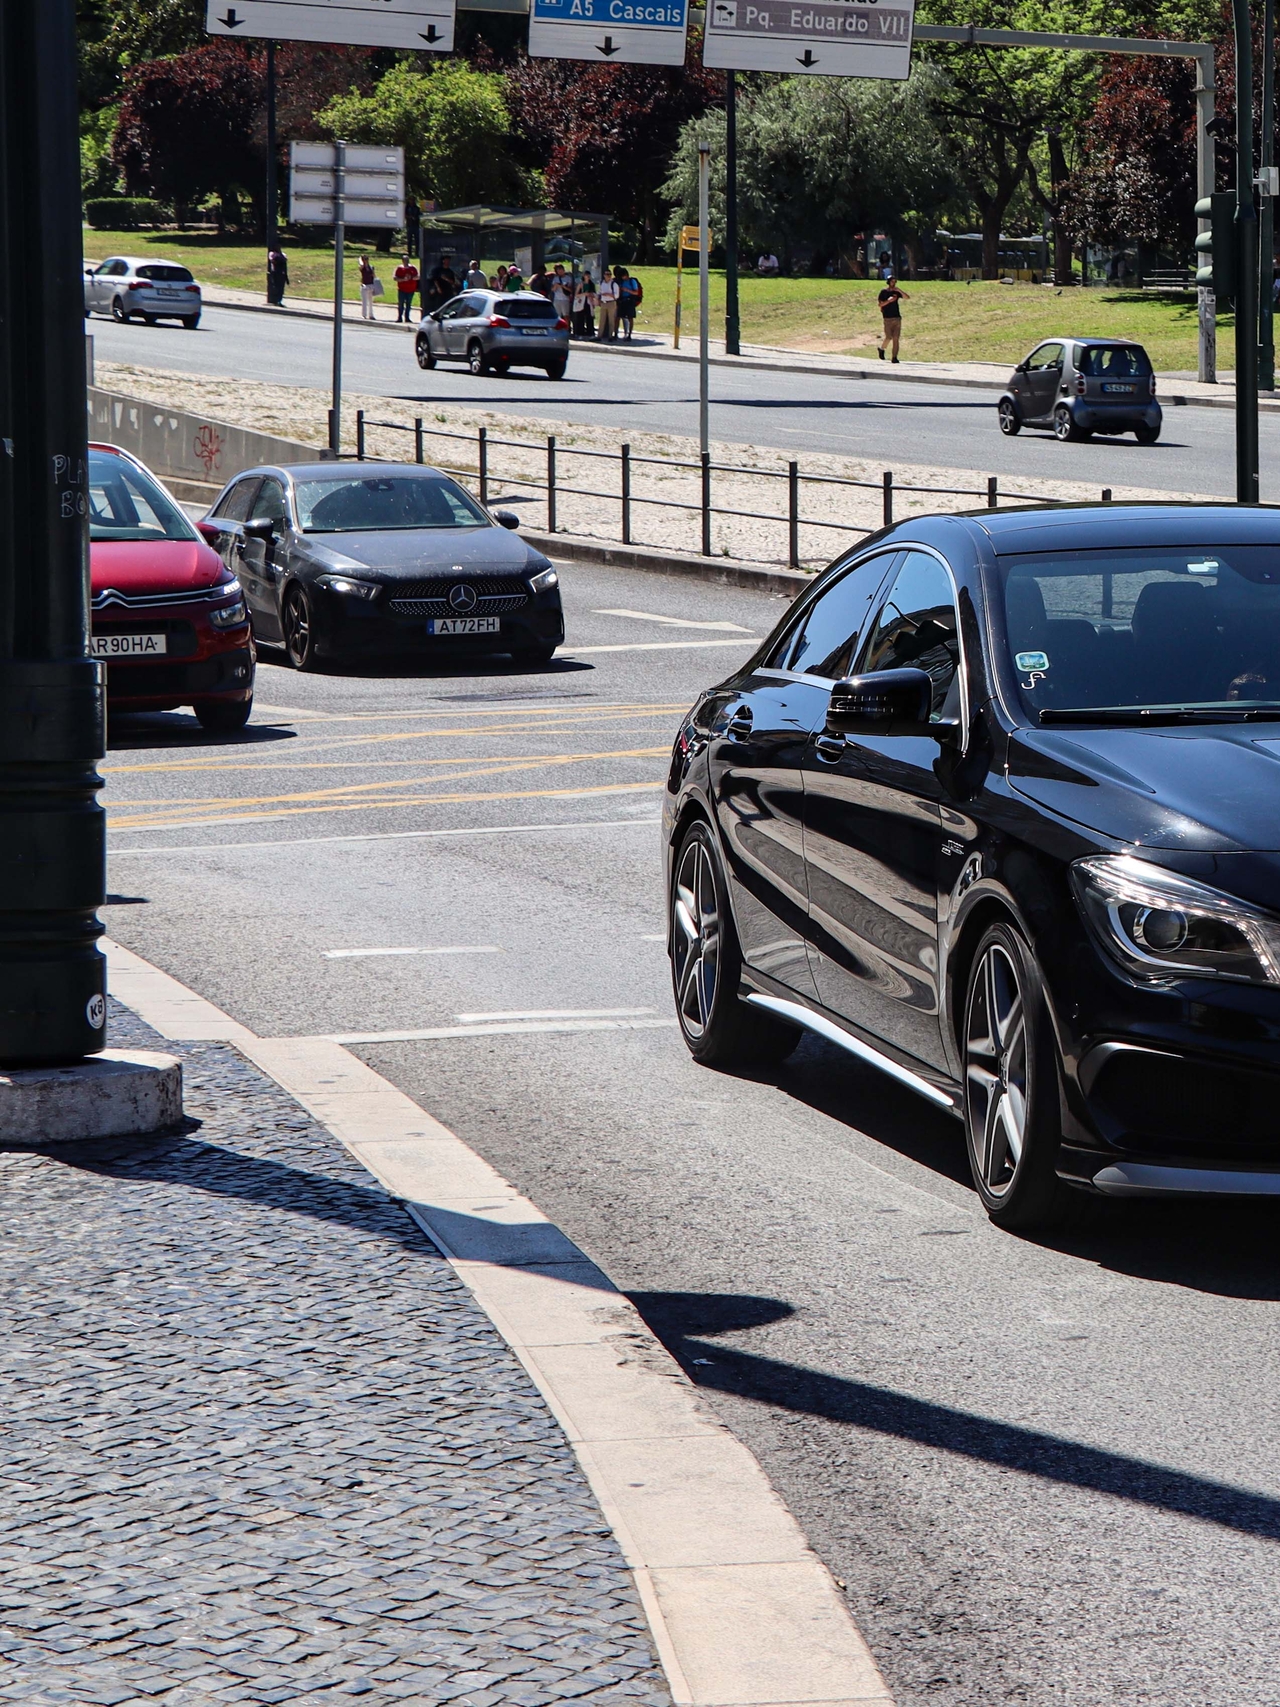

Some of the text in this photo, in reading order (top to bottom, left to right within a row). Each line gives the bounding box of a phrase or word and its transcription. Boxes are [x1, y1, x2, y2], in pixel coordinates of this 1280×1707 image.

[570, 0, 681, 22] A5 Cascais
[746, 6, 905, 34] Pq. Eduardo VII
